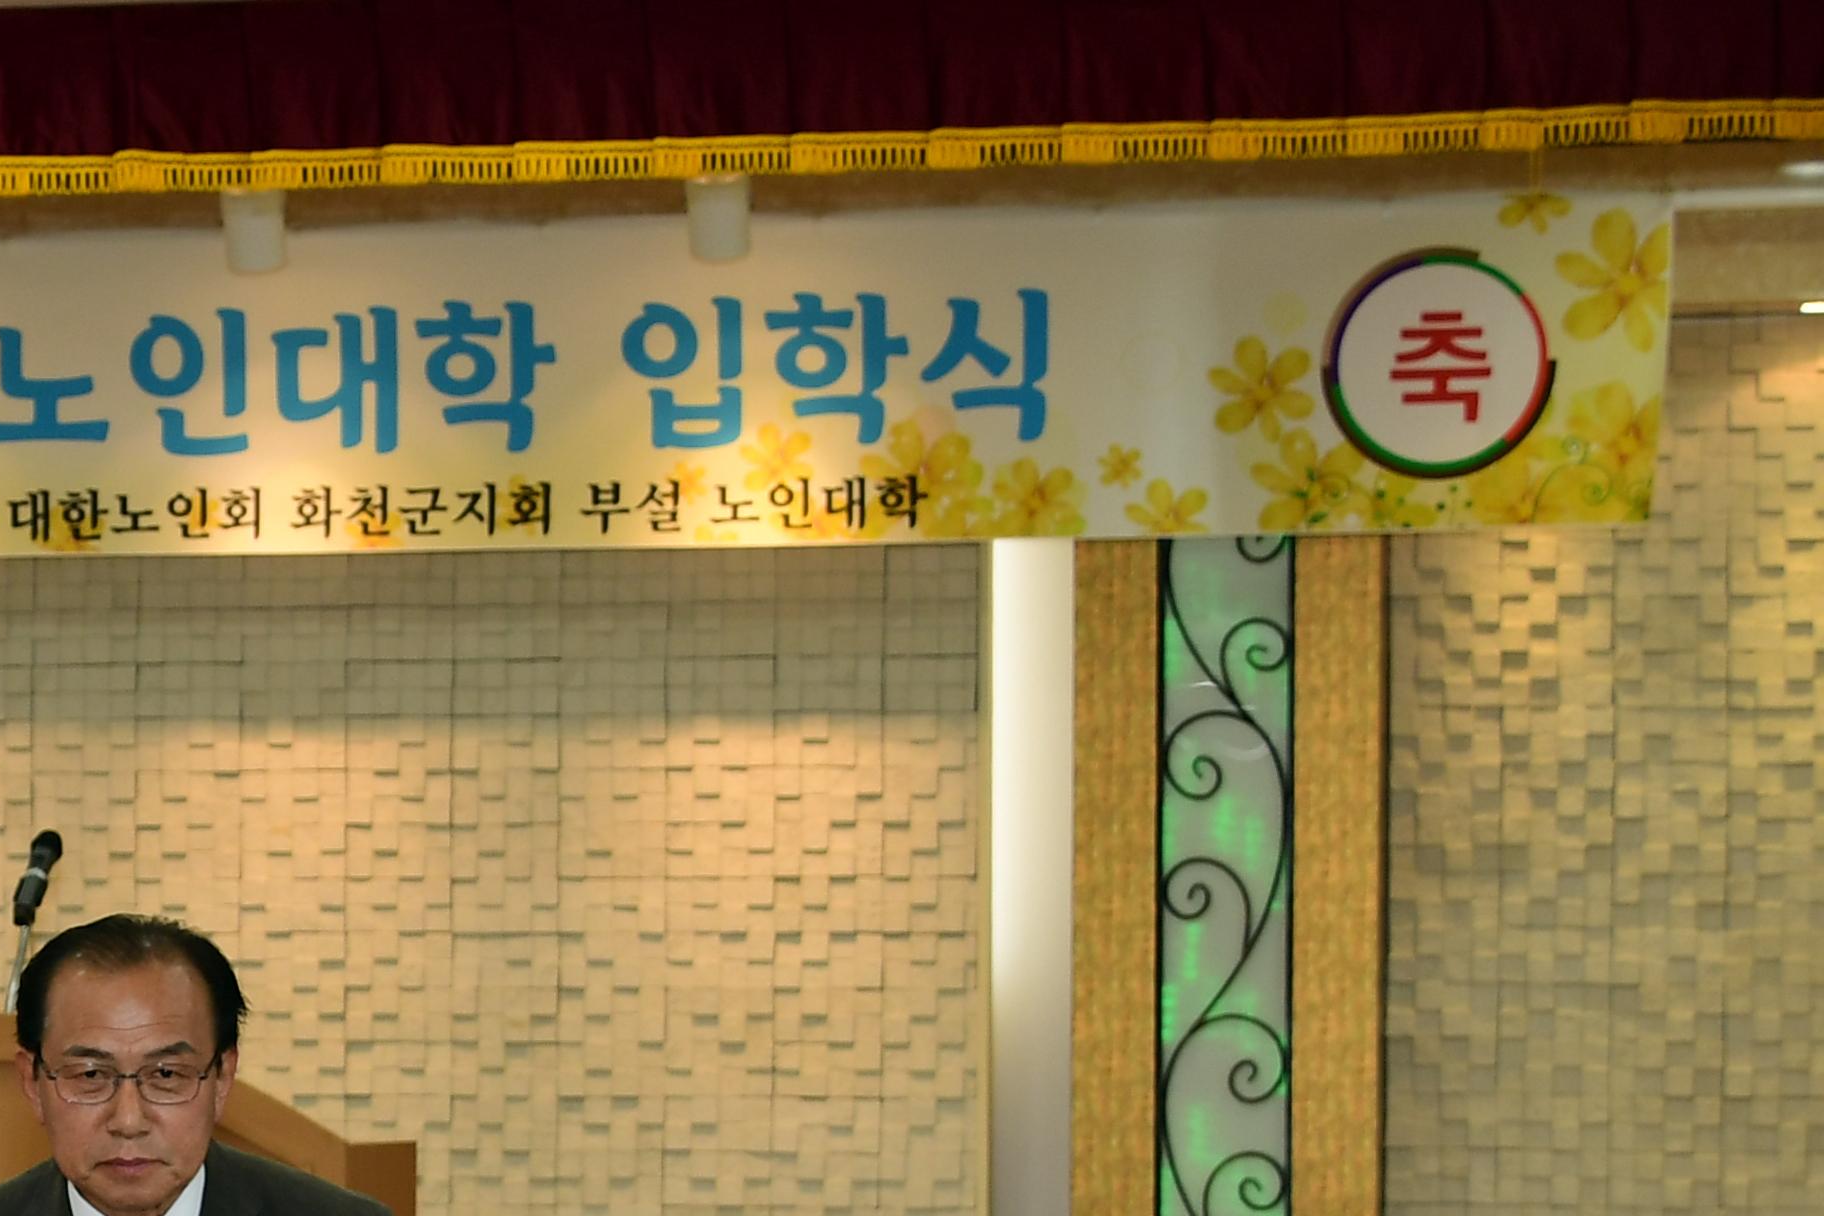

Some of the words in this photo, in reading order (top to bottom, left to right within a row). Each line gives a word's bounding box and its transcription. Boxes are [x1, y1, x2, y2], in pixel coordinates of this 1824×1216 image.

[621, 287, 1051, 448] 입학식
[1389, 310, 1493, 424] 축
[8, 486, 262, 542] 대한노인회
[289, 480, 553, 537] 화천군지회
[579, 477, 682, 533] 부설
[708, 473, 929, 530] 노인대학
